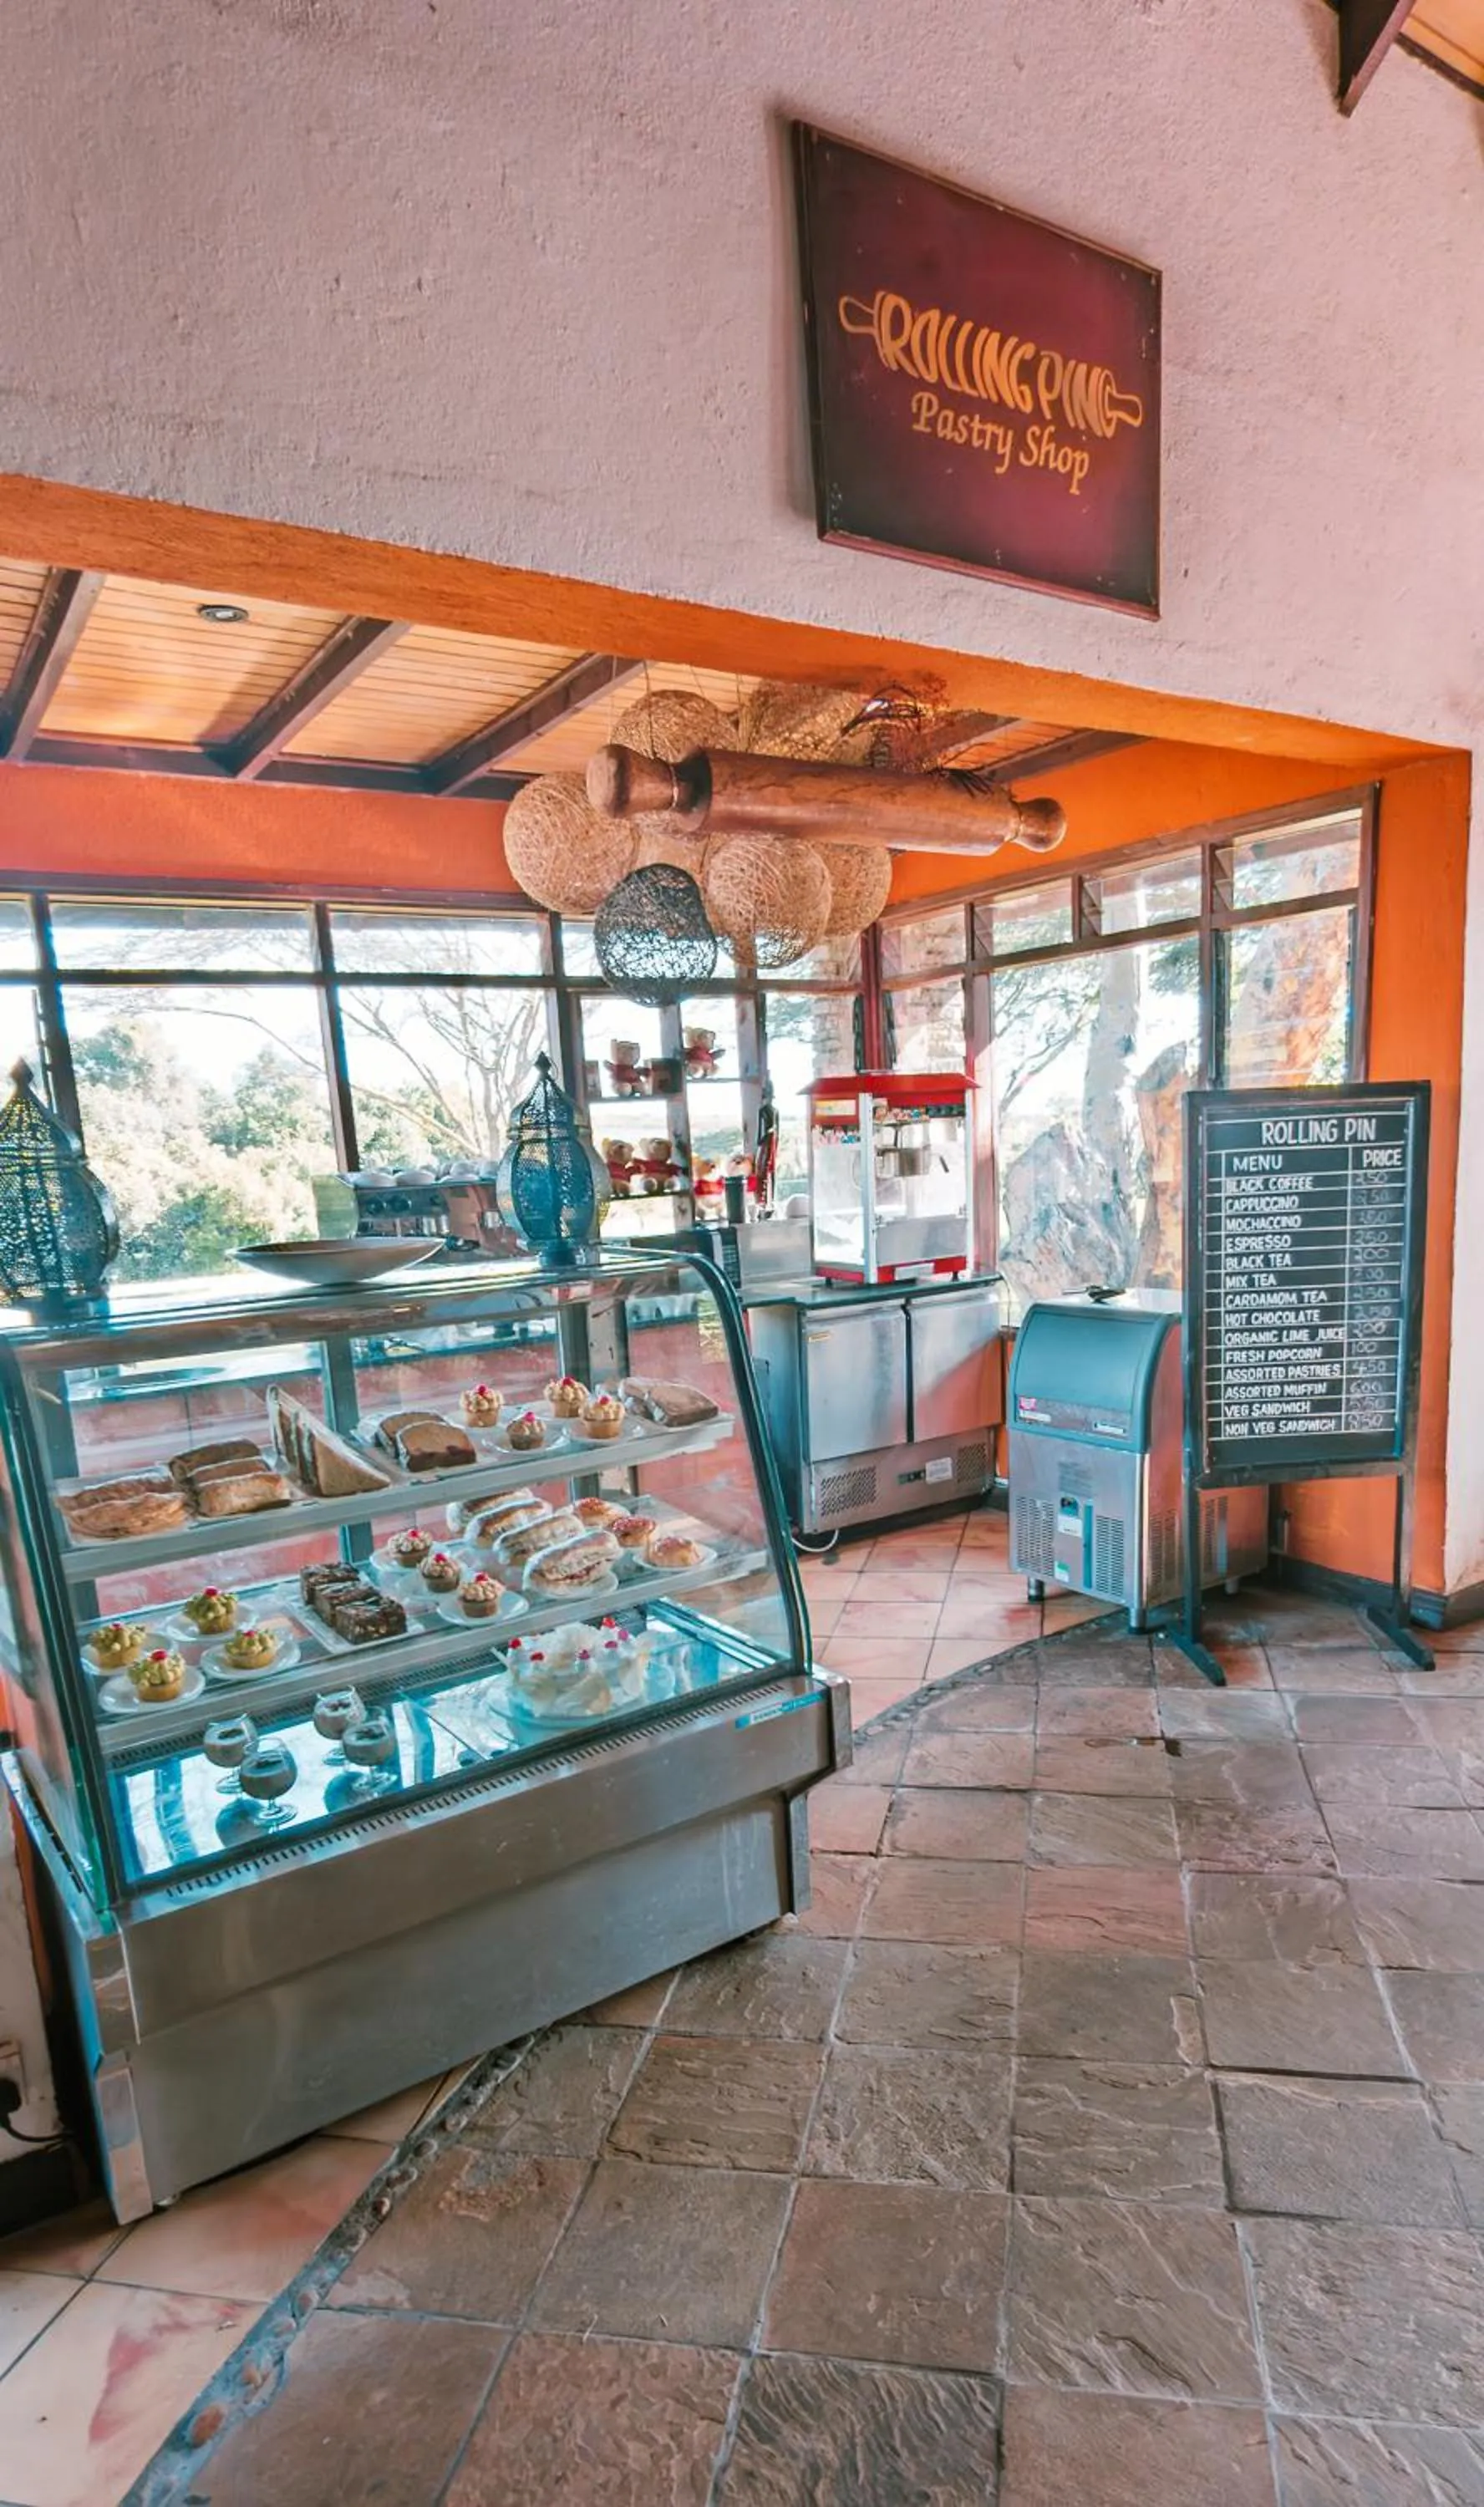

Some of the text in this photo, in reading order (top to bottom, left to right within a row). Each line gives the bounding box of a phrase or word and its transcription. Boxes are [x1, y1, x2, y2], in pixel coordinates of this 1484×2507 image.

[879, 292, 1105, 438] ROLLING PIN
[910, 390, 1090, 496] Pastry Shop
[1261, 1117, 1377, 1146] ROLLING PIN
[1232, 1154, 1283, 1172] MENU
[1363, 1148, 1403, 1168] PRICE
[1226, 1176, 1314, 1193] BLACK COFFEE
[1226, 1195, 1299, 1212] CAPPUCCINO
[1226, 1214, 1302, 1231] MOCHACCINO
[1225, 1235, 1291, 1252] ESPRESSO
[1225, 1253, 1293, 1270] BLACK TEA
[1226, 1273, 1278, 1289] MIX TEA
[1225, 1290, 1328, 1309] CARDAMOM TEA
[1225, 1309, 1320, 1327] HOT CHOCOLATE
[1225, 1327, 1346, 1345] ORGANIC LIME JUICE
[1225, 1347, 1323, 1363] FRESH POPCORN
[1352, 1341, 1377, 1355] 100
[1225, 1363, 1341, 1382] ASSORTED PASTRIES
[1353, 1359, 1387, 1375] 450
[1225, 1382, 1328, 1400] ASSORTED MUFFIN
[1224, 1401, 1311, 1418] VEG SANDWICH
[1225, 1418, 1336, 1437] NON VEG SANDWICH
